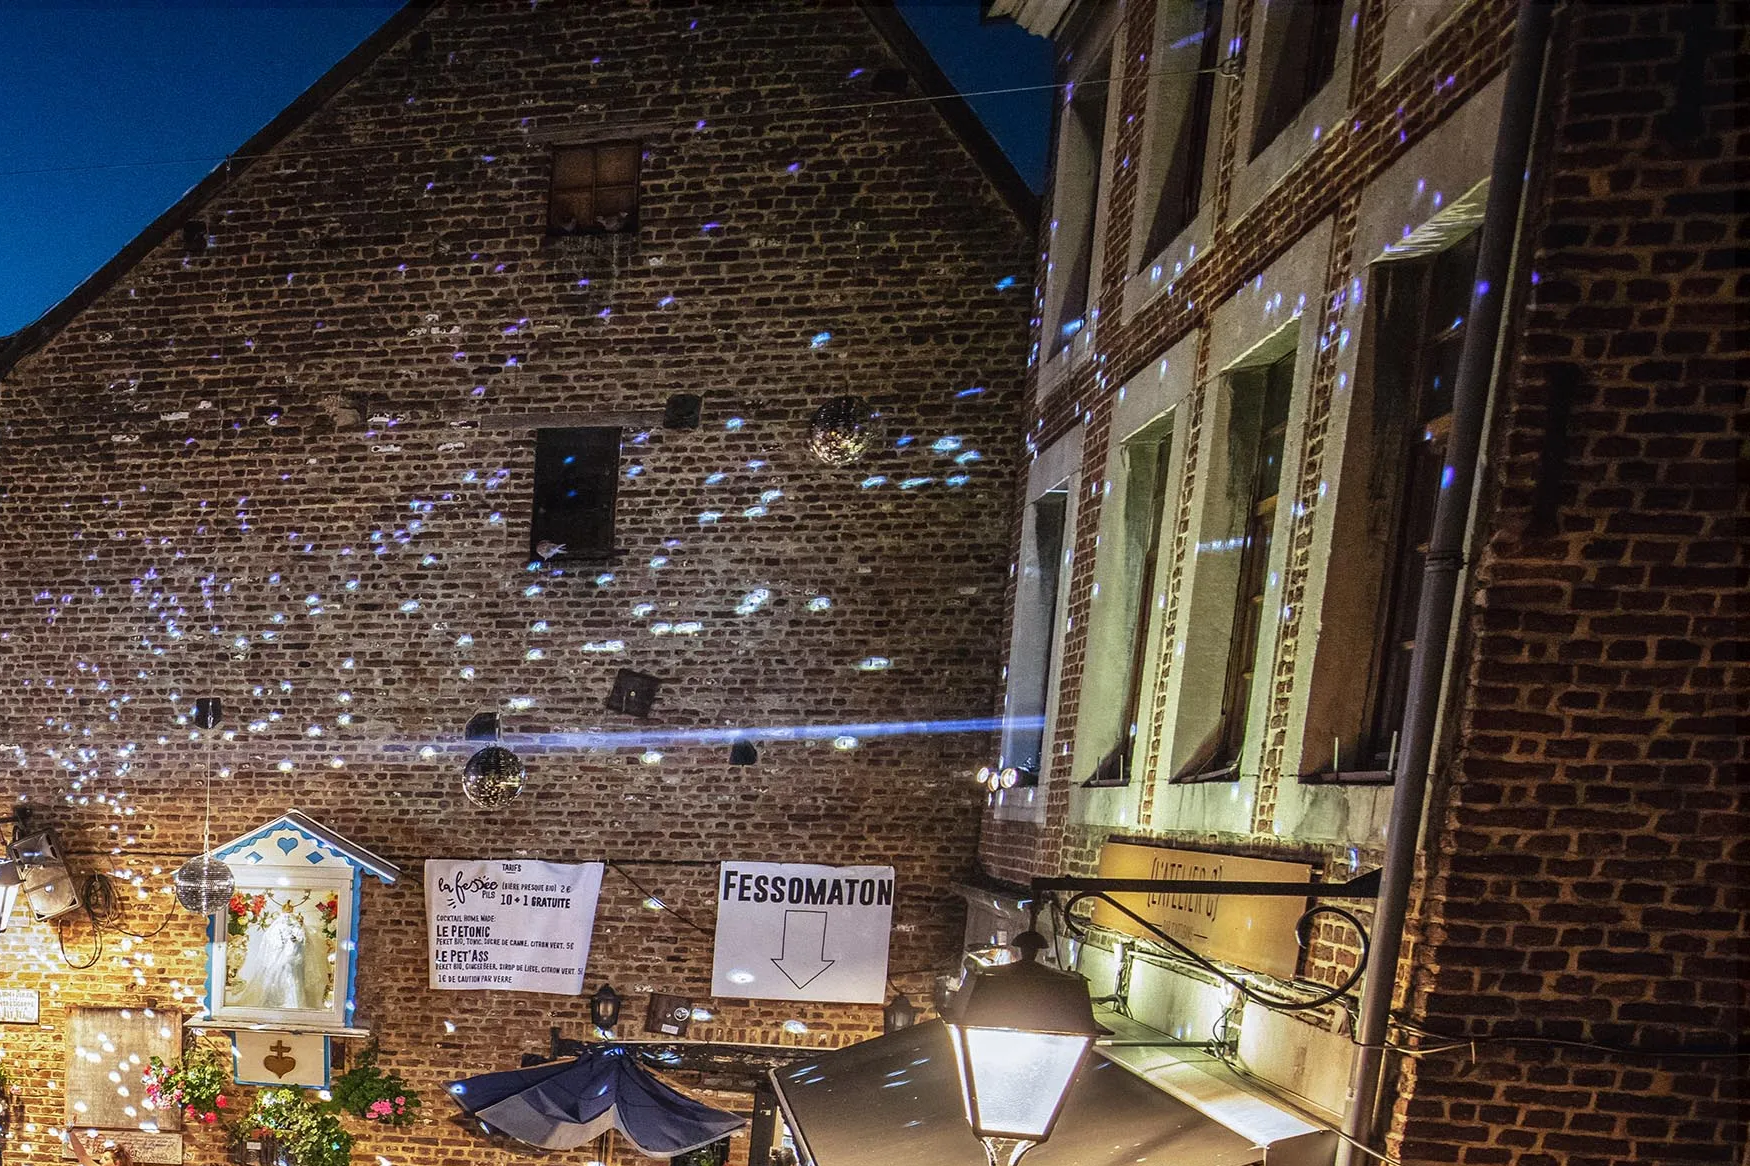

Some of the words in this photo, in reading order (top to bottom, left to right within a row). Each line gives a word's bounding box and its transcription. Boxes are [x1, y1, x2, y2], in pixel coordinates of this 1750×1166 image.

[502, 863, 522, 872] TARIFS
[438, 877, 454, 893] la
[455, 871, 499, 904] fessée
[521, 883, 545, 892] PRESQUE
[545, 884, 557, 893] BIO)
[723, 870, 893, 906] FESSOMATON
[481, 891, 496, 899] PILS
[500, 894, 512, 905] 10
[523, 895, 529, 906] 1
[531, 897, 571, 909] GRATUITE
[436, 914, 463, 922] COCKTAIL
[437, 925, 449, 937] LE
[451, 925, 491, 938] PETONIC
[454, 938, 465, 946] BIO,
[484, 938, 500, 946] SUCRE
[436, 949, 448, 962] LE
[450, 949, 489, 962] PET'ASS
[453, 963, 465, 971] BIO,
[499, 963, 516, 971] SIROP
[541, 966, 560, 974] CITRON
[438, 974, 447, 983] 1€
[448, 975, 456, 983] DE
[457, 975, 481, 983] CAUTION
[481, 975, 492, 983] PAR
[493, 975, 512, 983] VERRE
